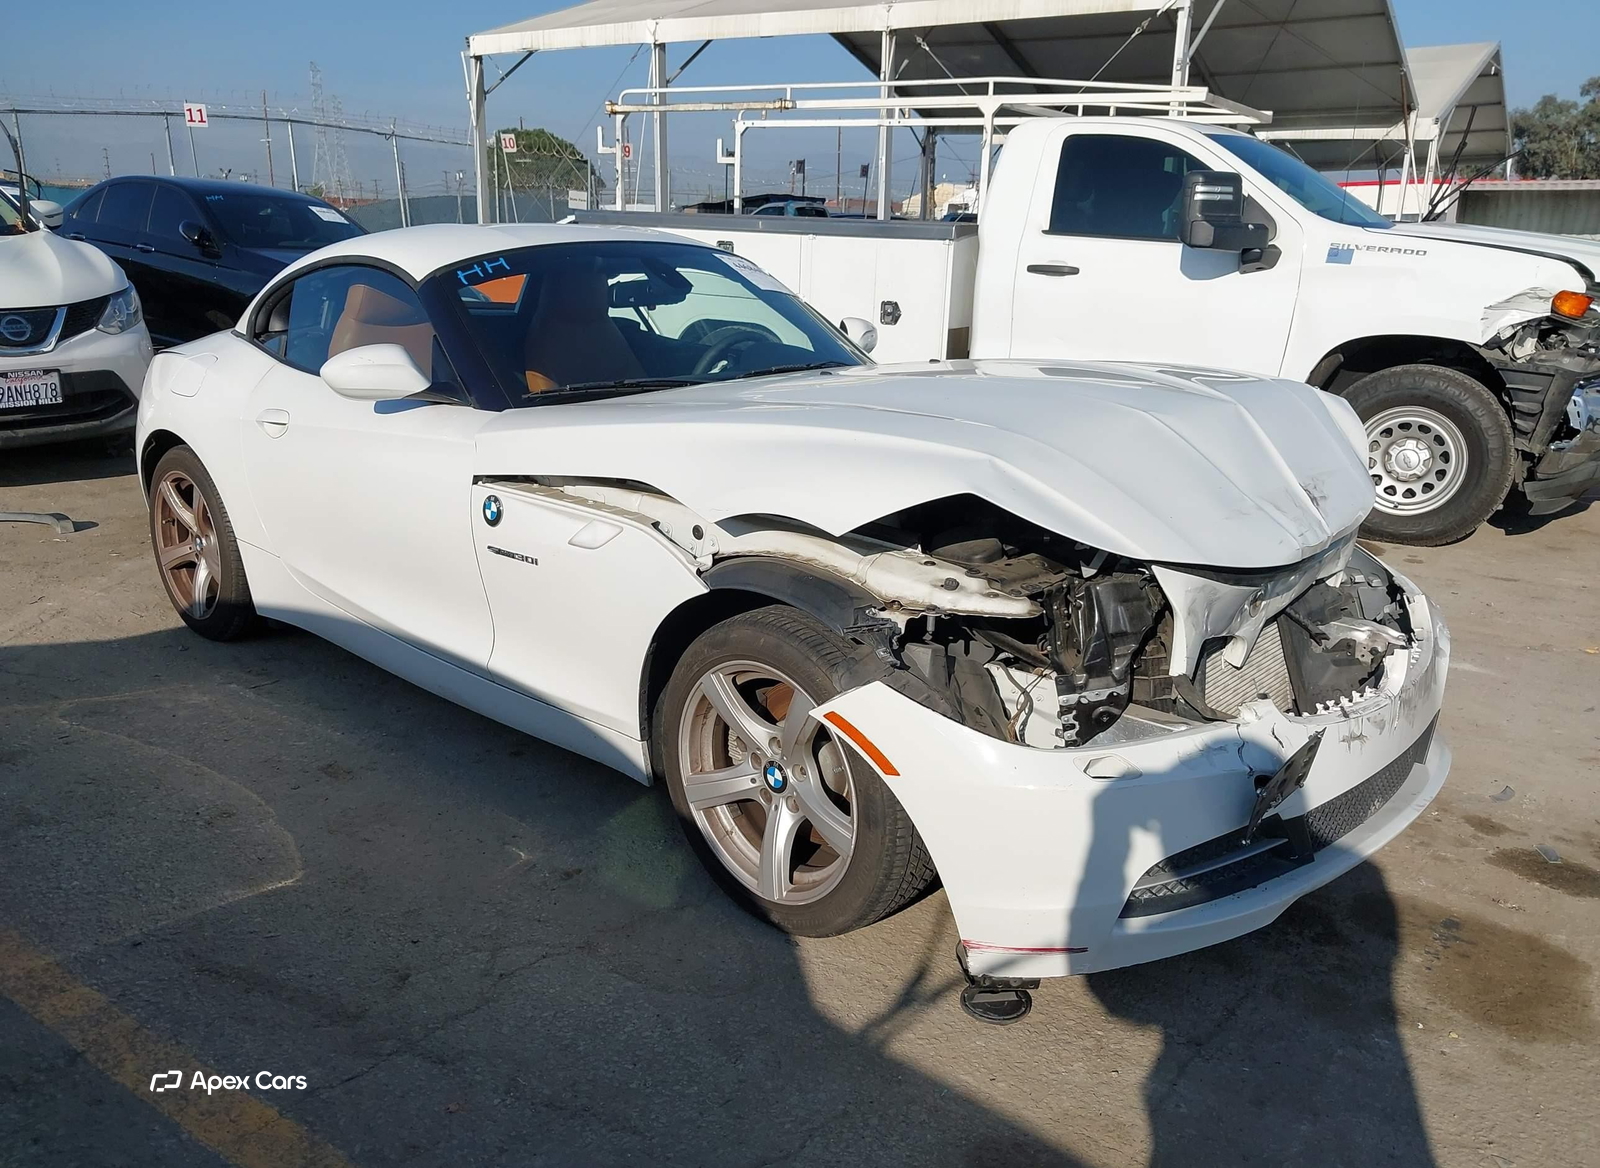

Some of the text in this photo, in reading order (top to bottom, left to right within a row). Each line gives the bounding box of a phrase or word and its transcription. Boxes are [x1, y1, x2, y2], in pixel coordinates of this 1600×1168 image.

[186, 108, 206, 123] 11
[503, 138, 515, 149] 10
[623, 145, 631, 158] 9
[7, 370, 43, 378] NISSAN
[0, 397, 63, 409] MISSION HILLS
